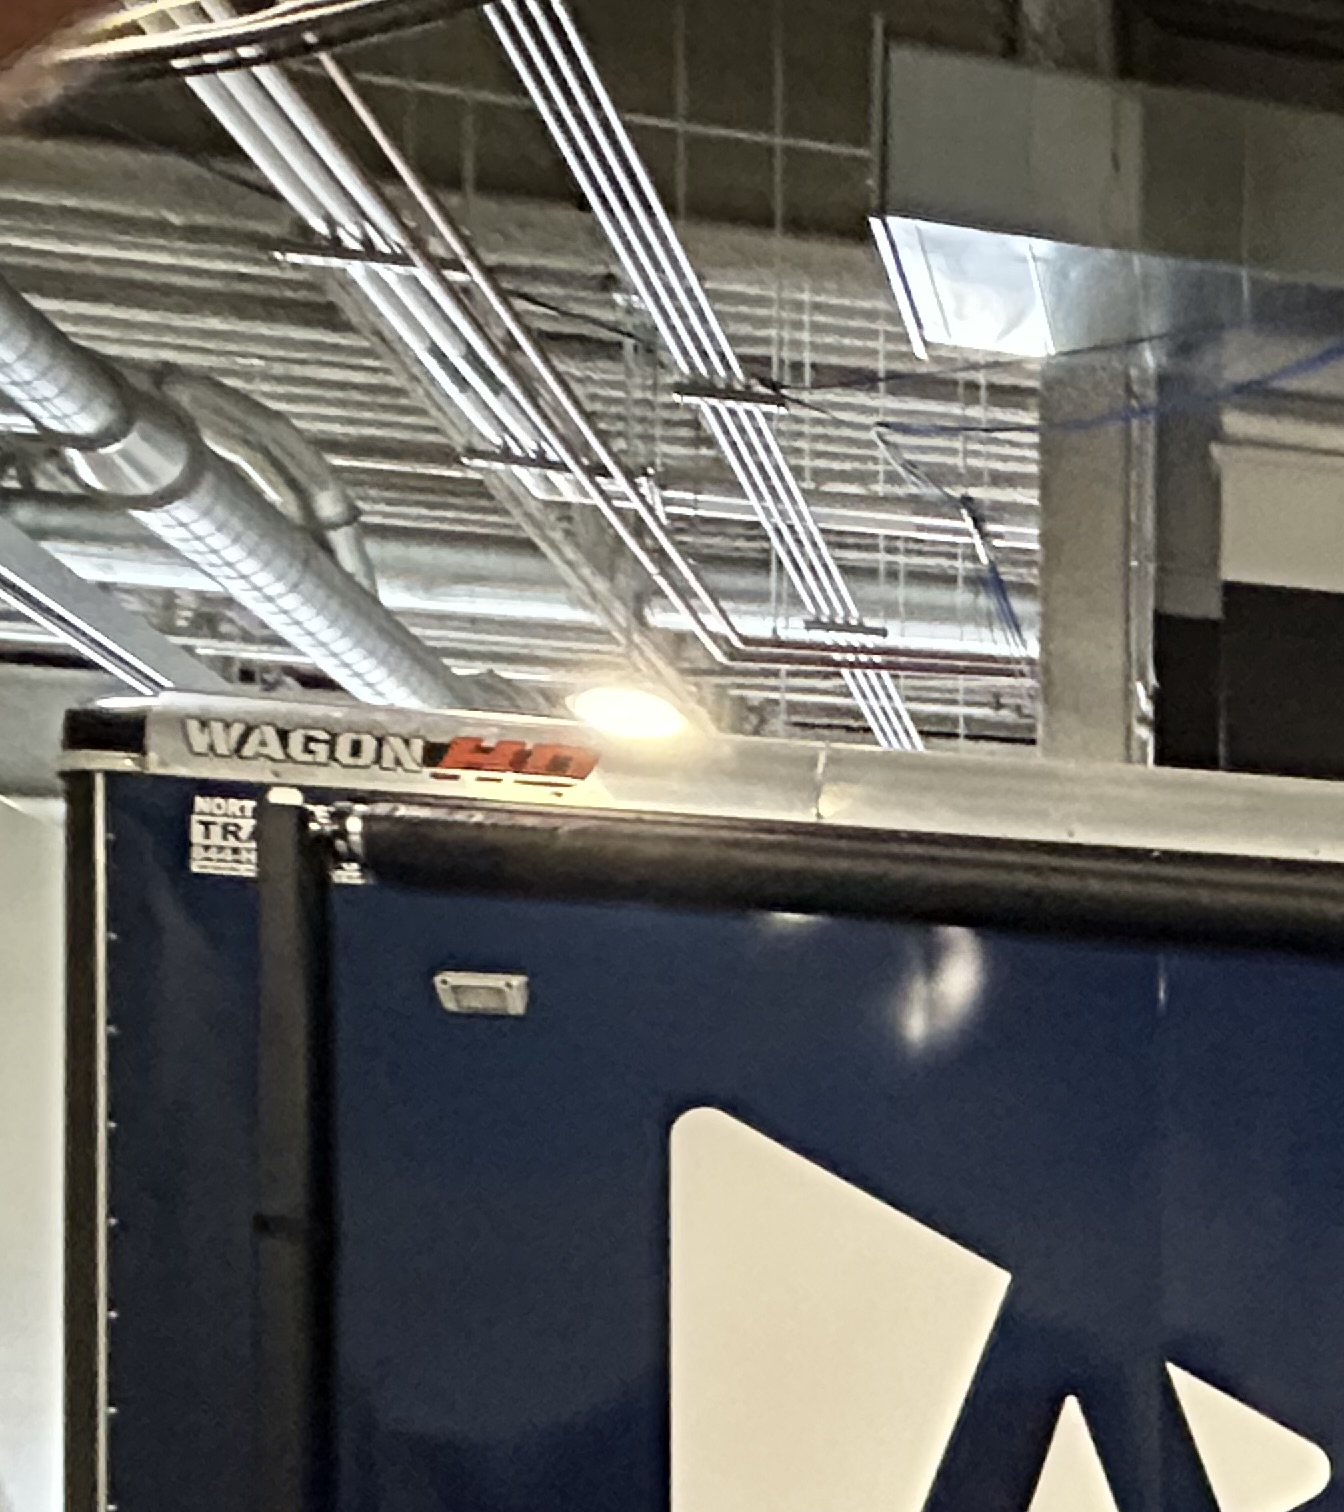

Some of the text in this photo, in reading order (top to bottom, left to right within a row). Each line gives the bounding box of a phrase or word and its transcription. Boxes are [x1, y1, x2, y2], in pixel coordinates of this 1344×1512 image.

[184, 718, 425, 773] WAGON
[193, 796, 258, 818] NORT
[195, 819, 257, 842] TR
